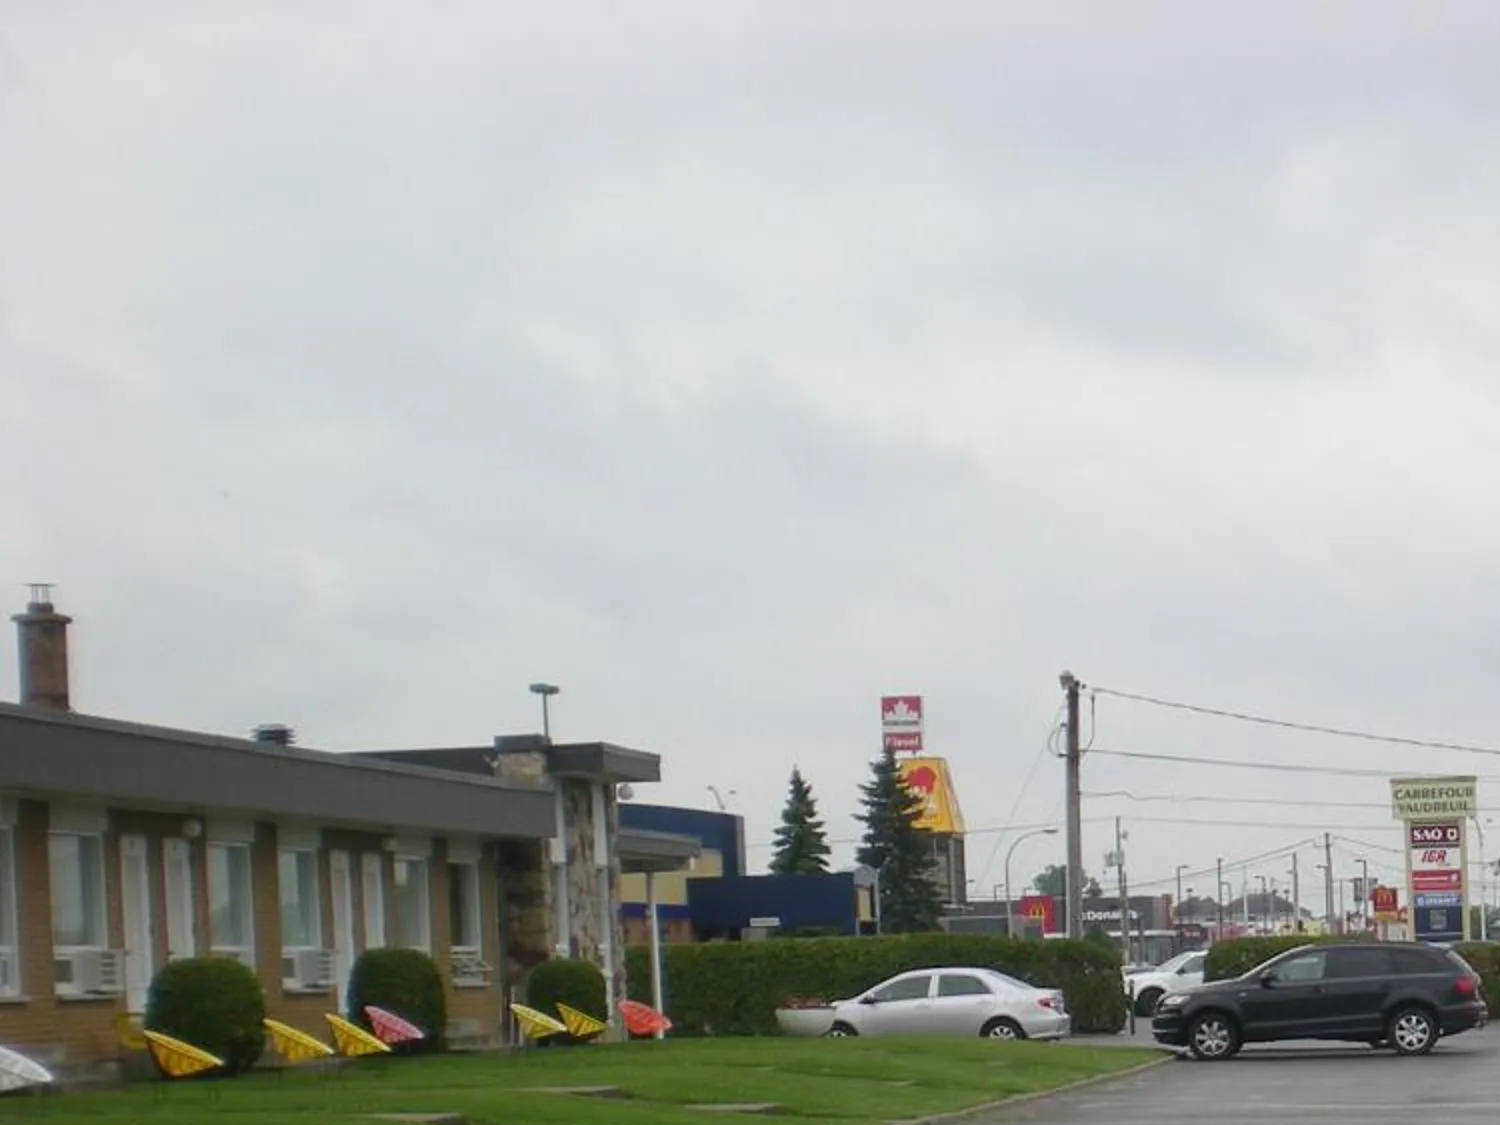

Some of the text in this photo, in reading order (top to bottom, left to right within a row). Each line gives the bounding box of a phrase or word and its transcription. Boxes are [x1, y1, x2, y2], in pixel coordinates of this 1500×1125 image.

[1394, 786, 1474, 800] CARREFOUR
[1399, 800, 1469, 814] VAUDREUIL
[1413, 827, 1442, 842] SAQ
[1421, 849, 1448, 864] IGA
